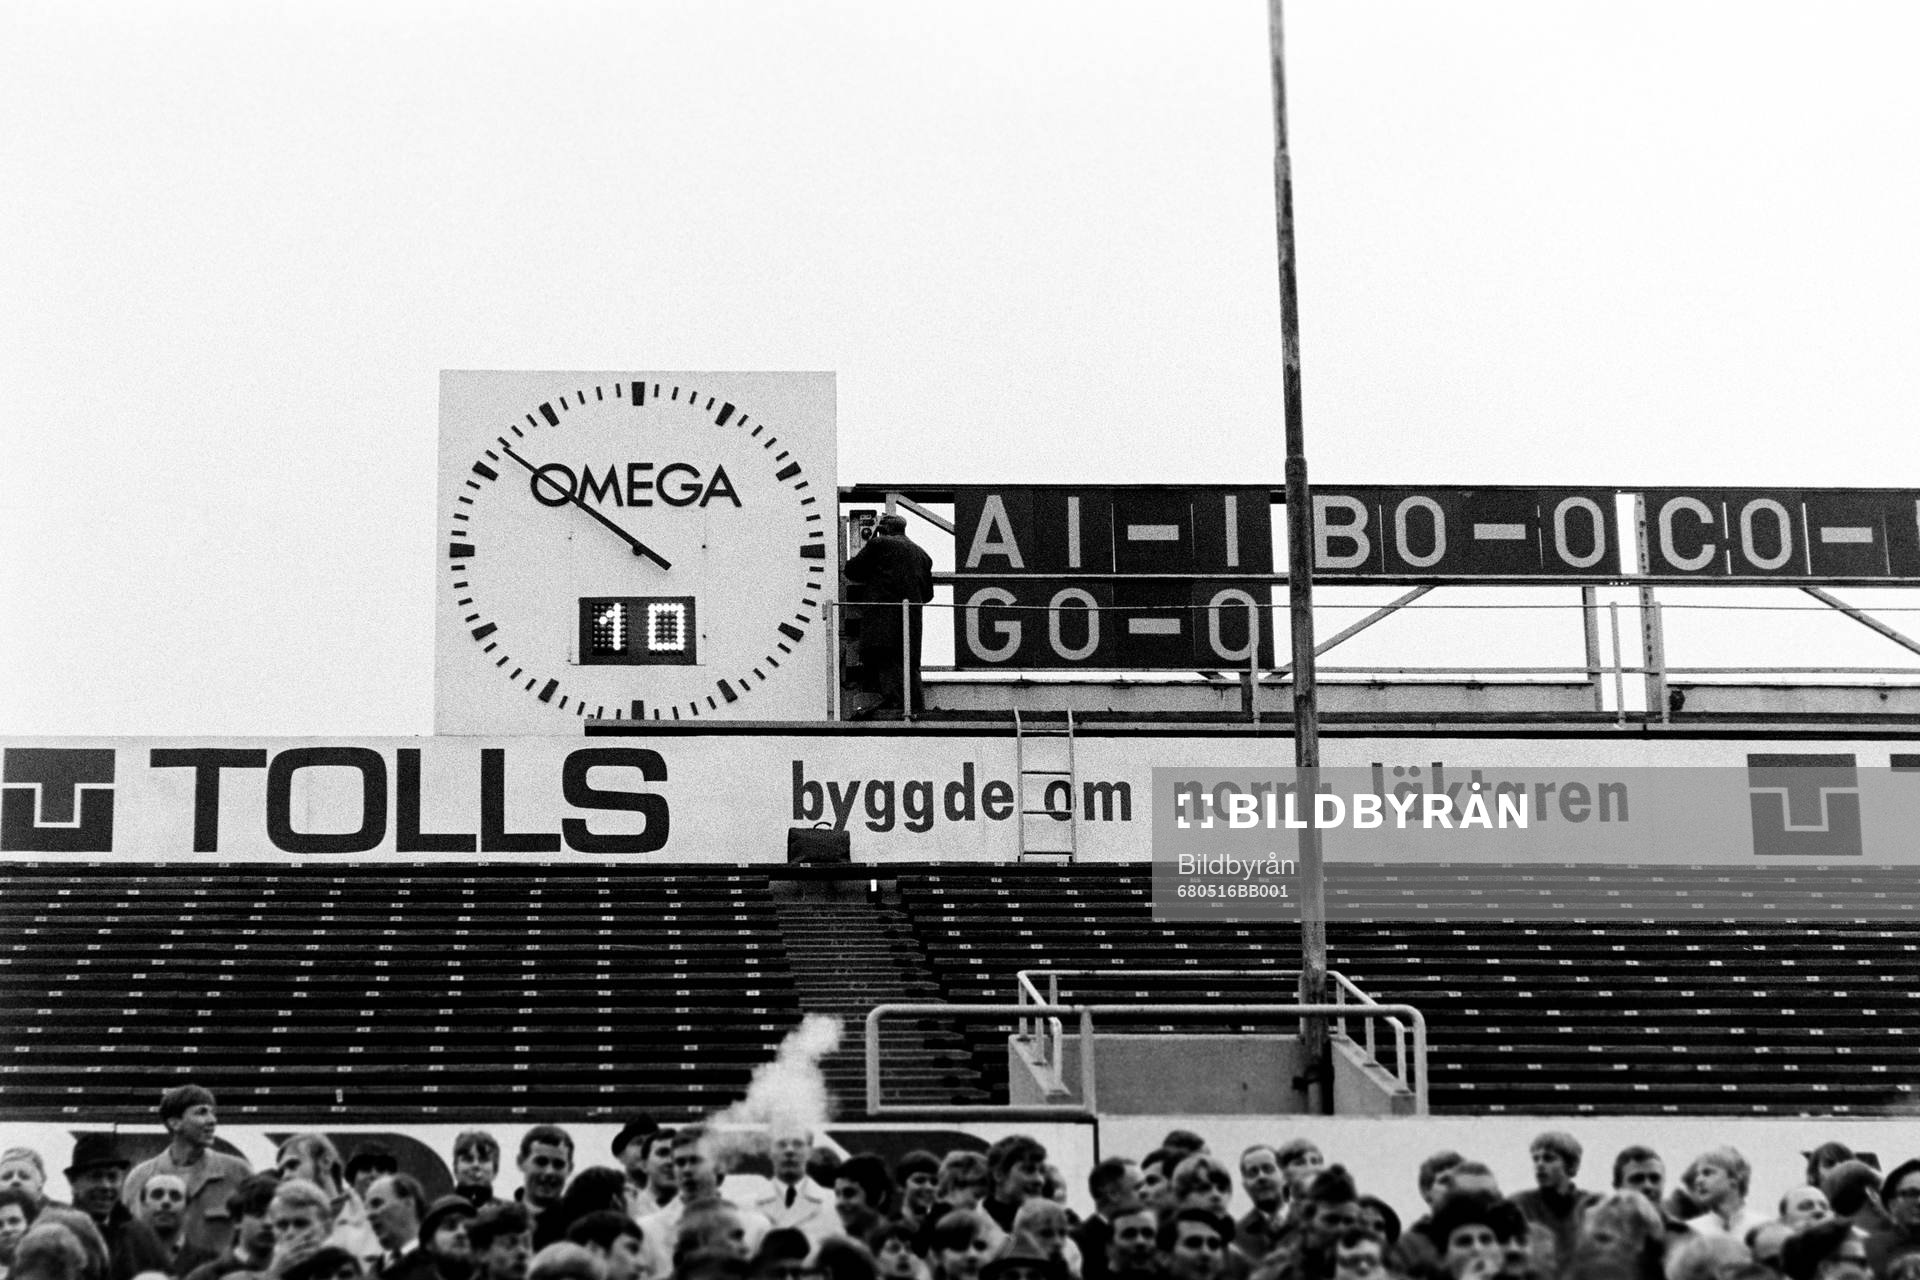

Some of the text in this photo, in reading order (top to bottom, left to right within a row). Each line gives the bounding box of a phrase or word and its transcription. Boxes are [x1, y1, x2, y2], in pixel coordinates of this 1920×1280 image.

[530, 462, 742, 507] OMEGA
[598, 601, 686, 652] 10
[150, 746, 670, 853] TOLLS
[792, 760, 1015, 834] byggde
[1045, 779, 1132, 822] om
